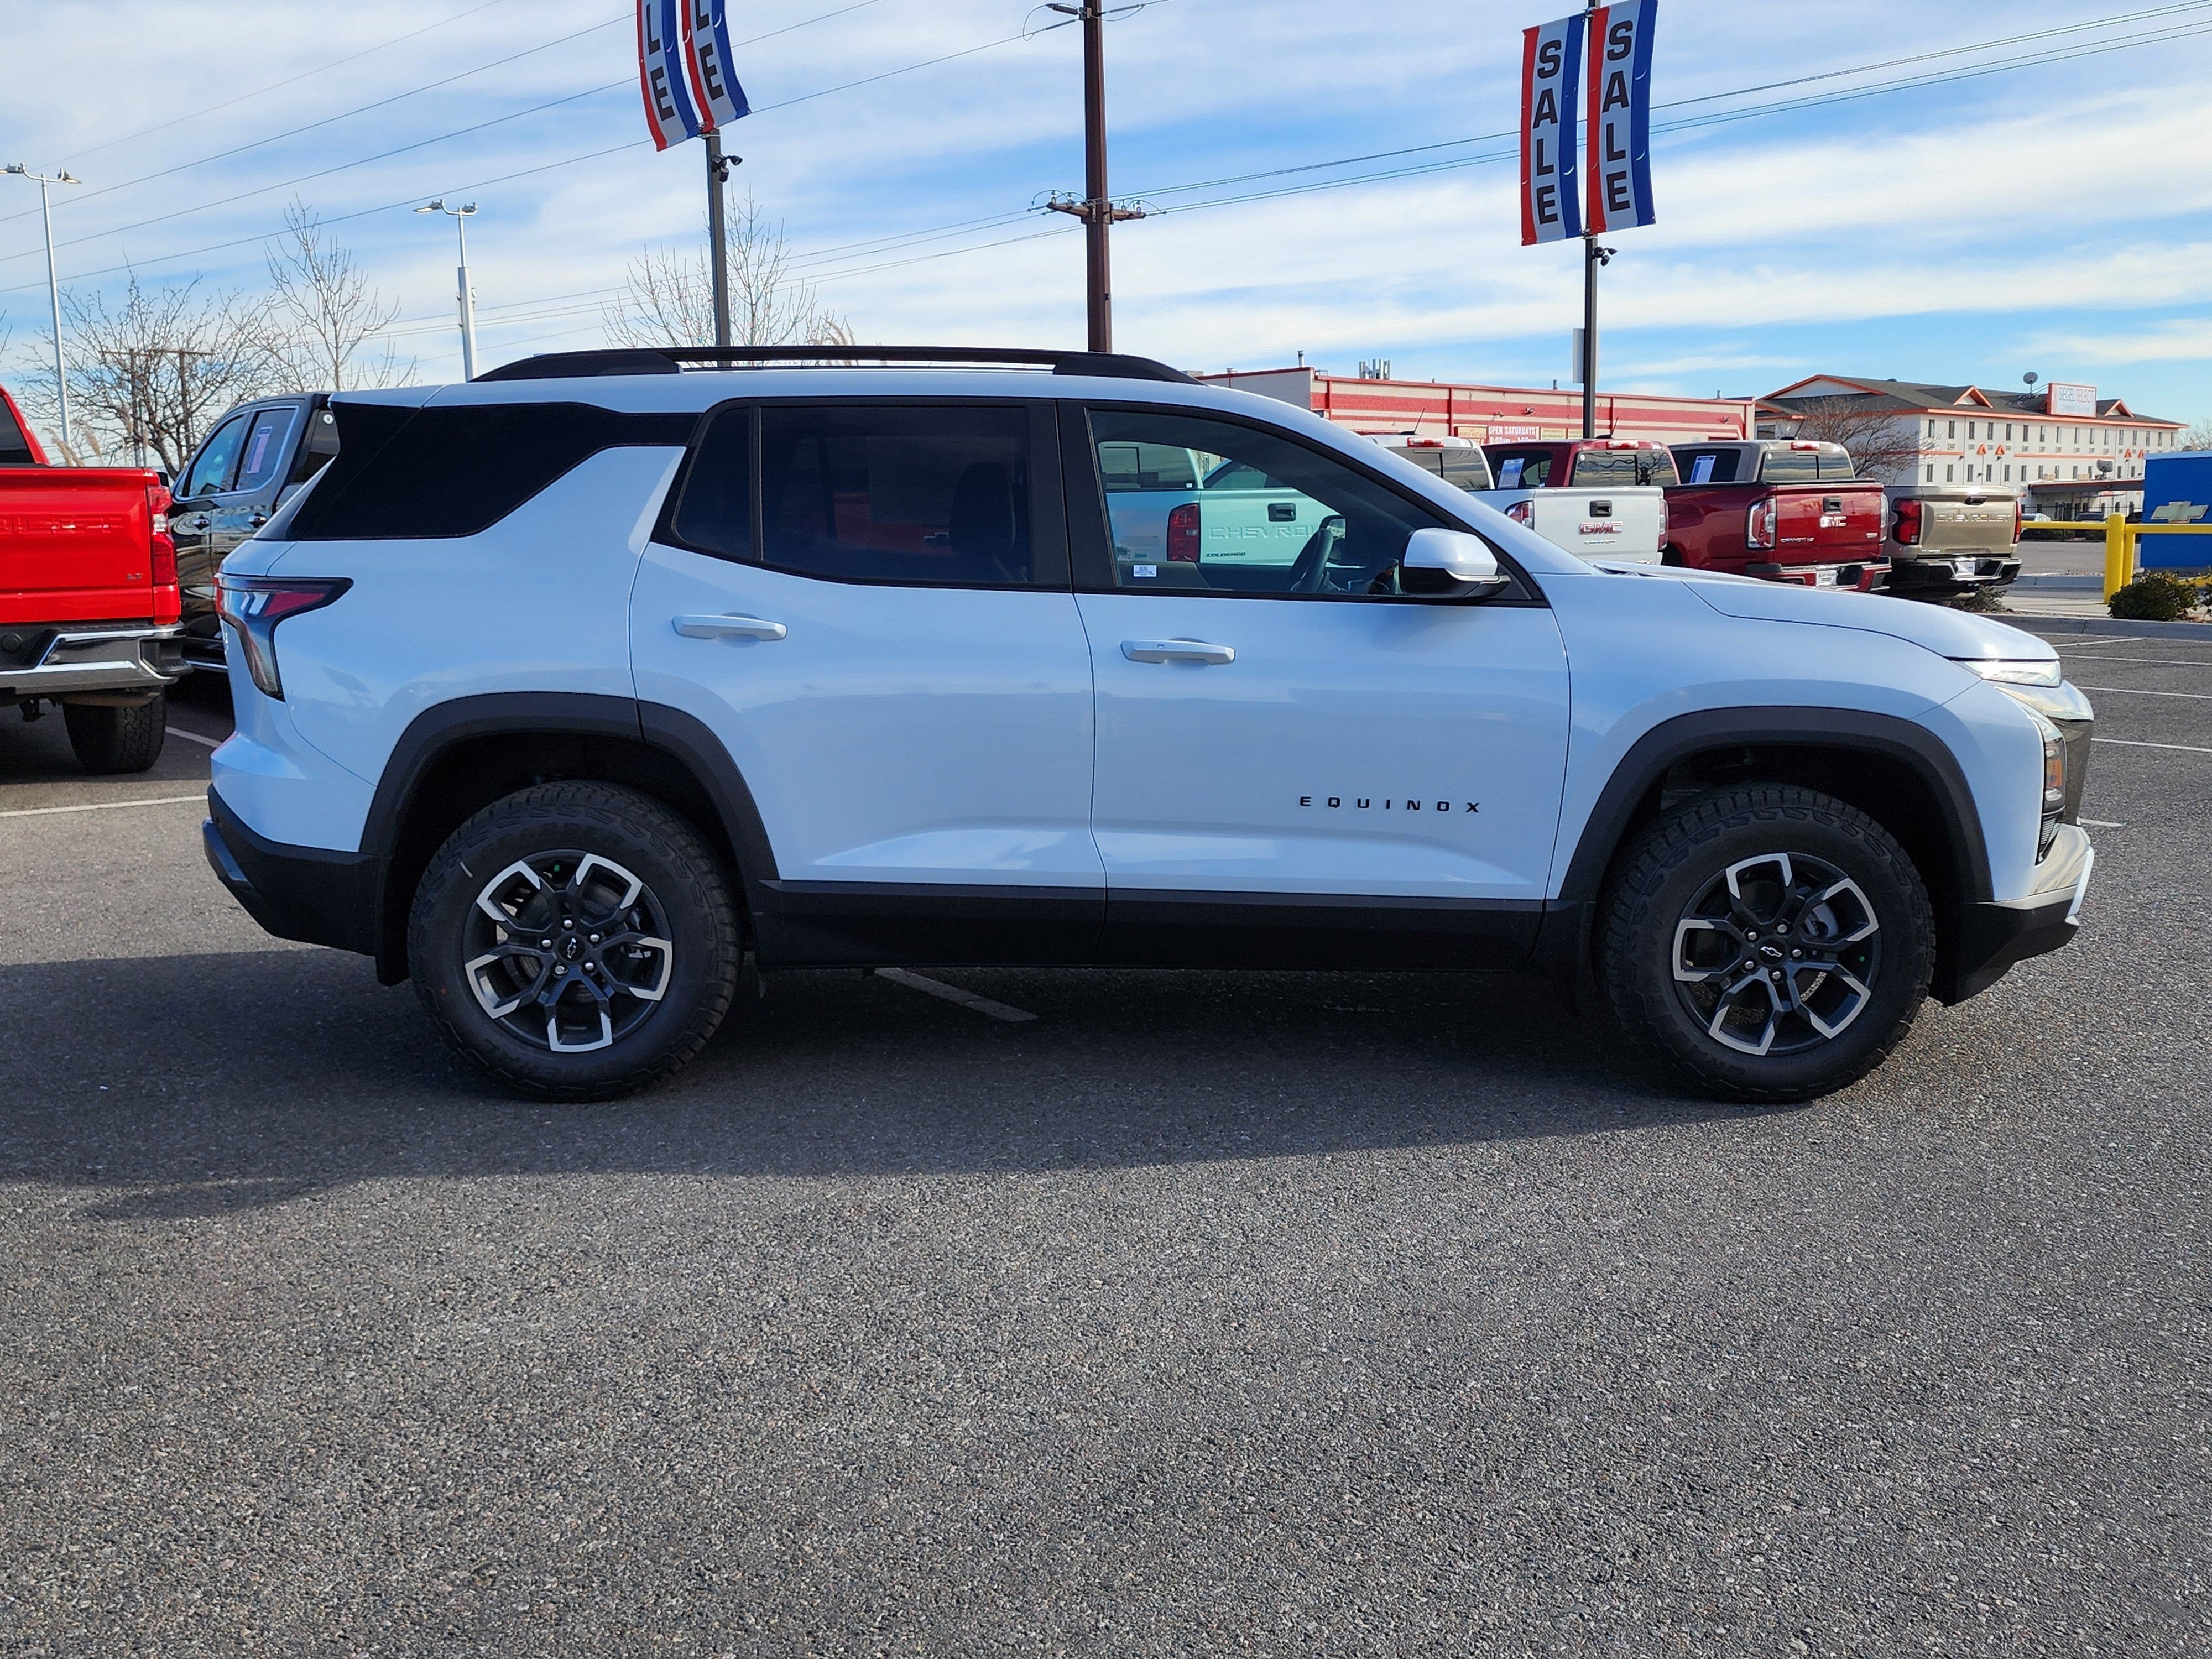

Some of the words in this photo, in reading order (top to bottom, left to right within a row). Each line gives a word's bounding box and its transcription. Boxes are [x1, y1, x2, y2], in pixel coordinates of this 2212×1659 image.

[1602, 20, 1634, 212] SALE
[1532, 40, 1562, 225] SALE
[1489, 426, 1503, 435] OPEN
[1505, 426, 1536, 435] SATURDAYS
[1936, 514, 2012, 522] CHEVROLET
[1579, 521, 1623, 535] GMC
[1300, 796, 1480, 813] EQUINOX
